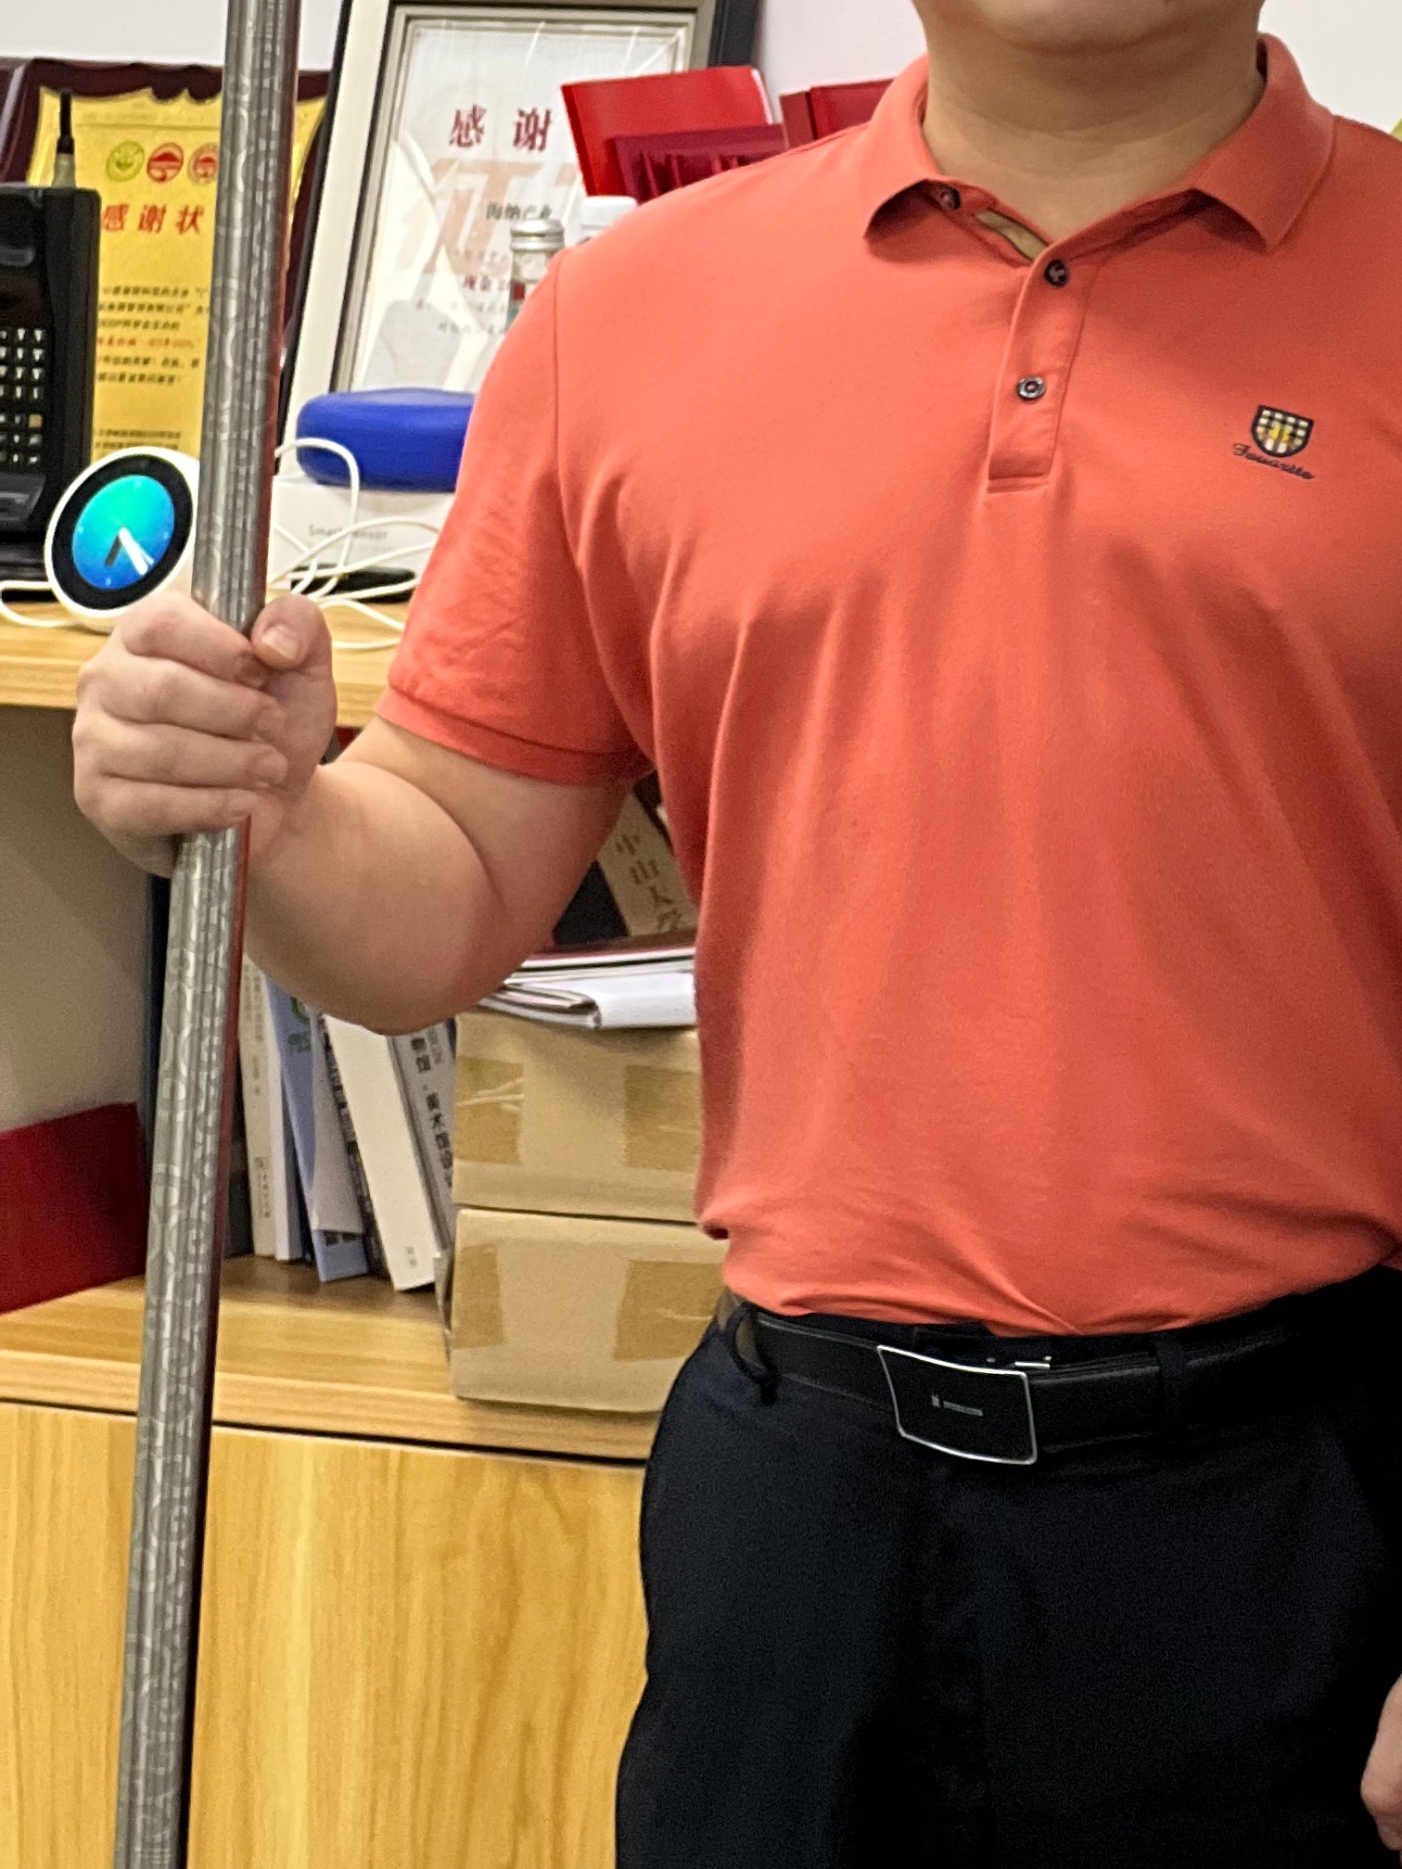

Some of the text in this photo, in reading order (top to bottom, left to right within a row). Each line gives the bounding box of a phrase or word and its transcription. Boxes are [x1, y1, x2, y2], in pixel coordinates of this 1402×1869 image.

[448, 103, 552, 152] 感谢
[102, 202, 204, 235] 感谢状
